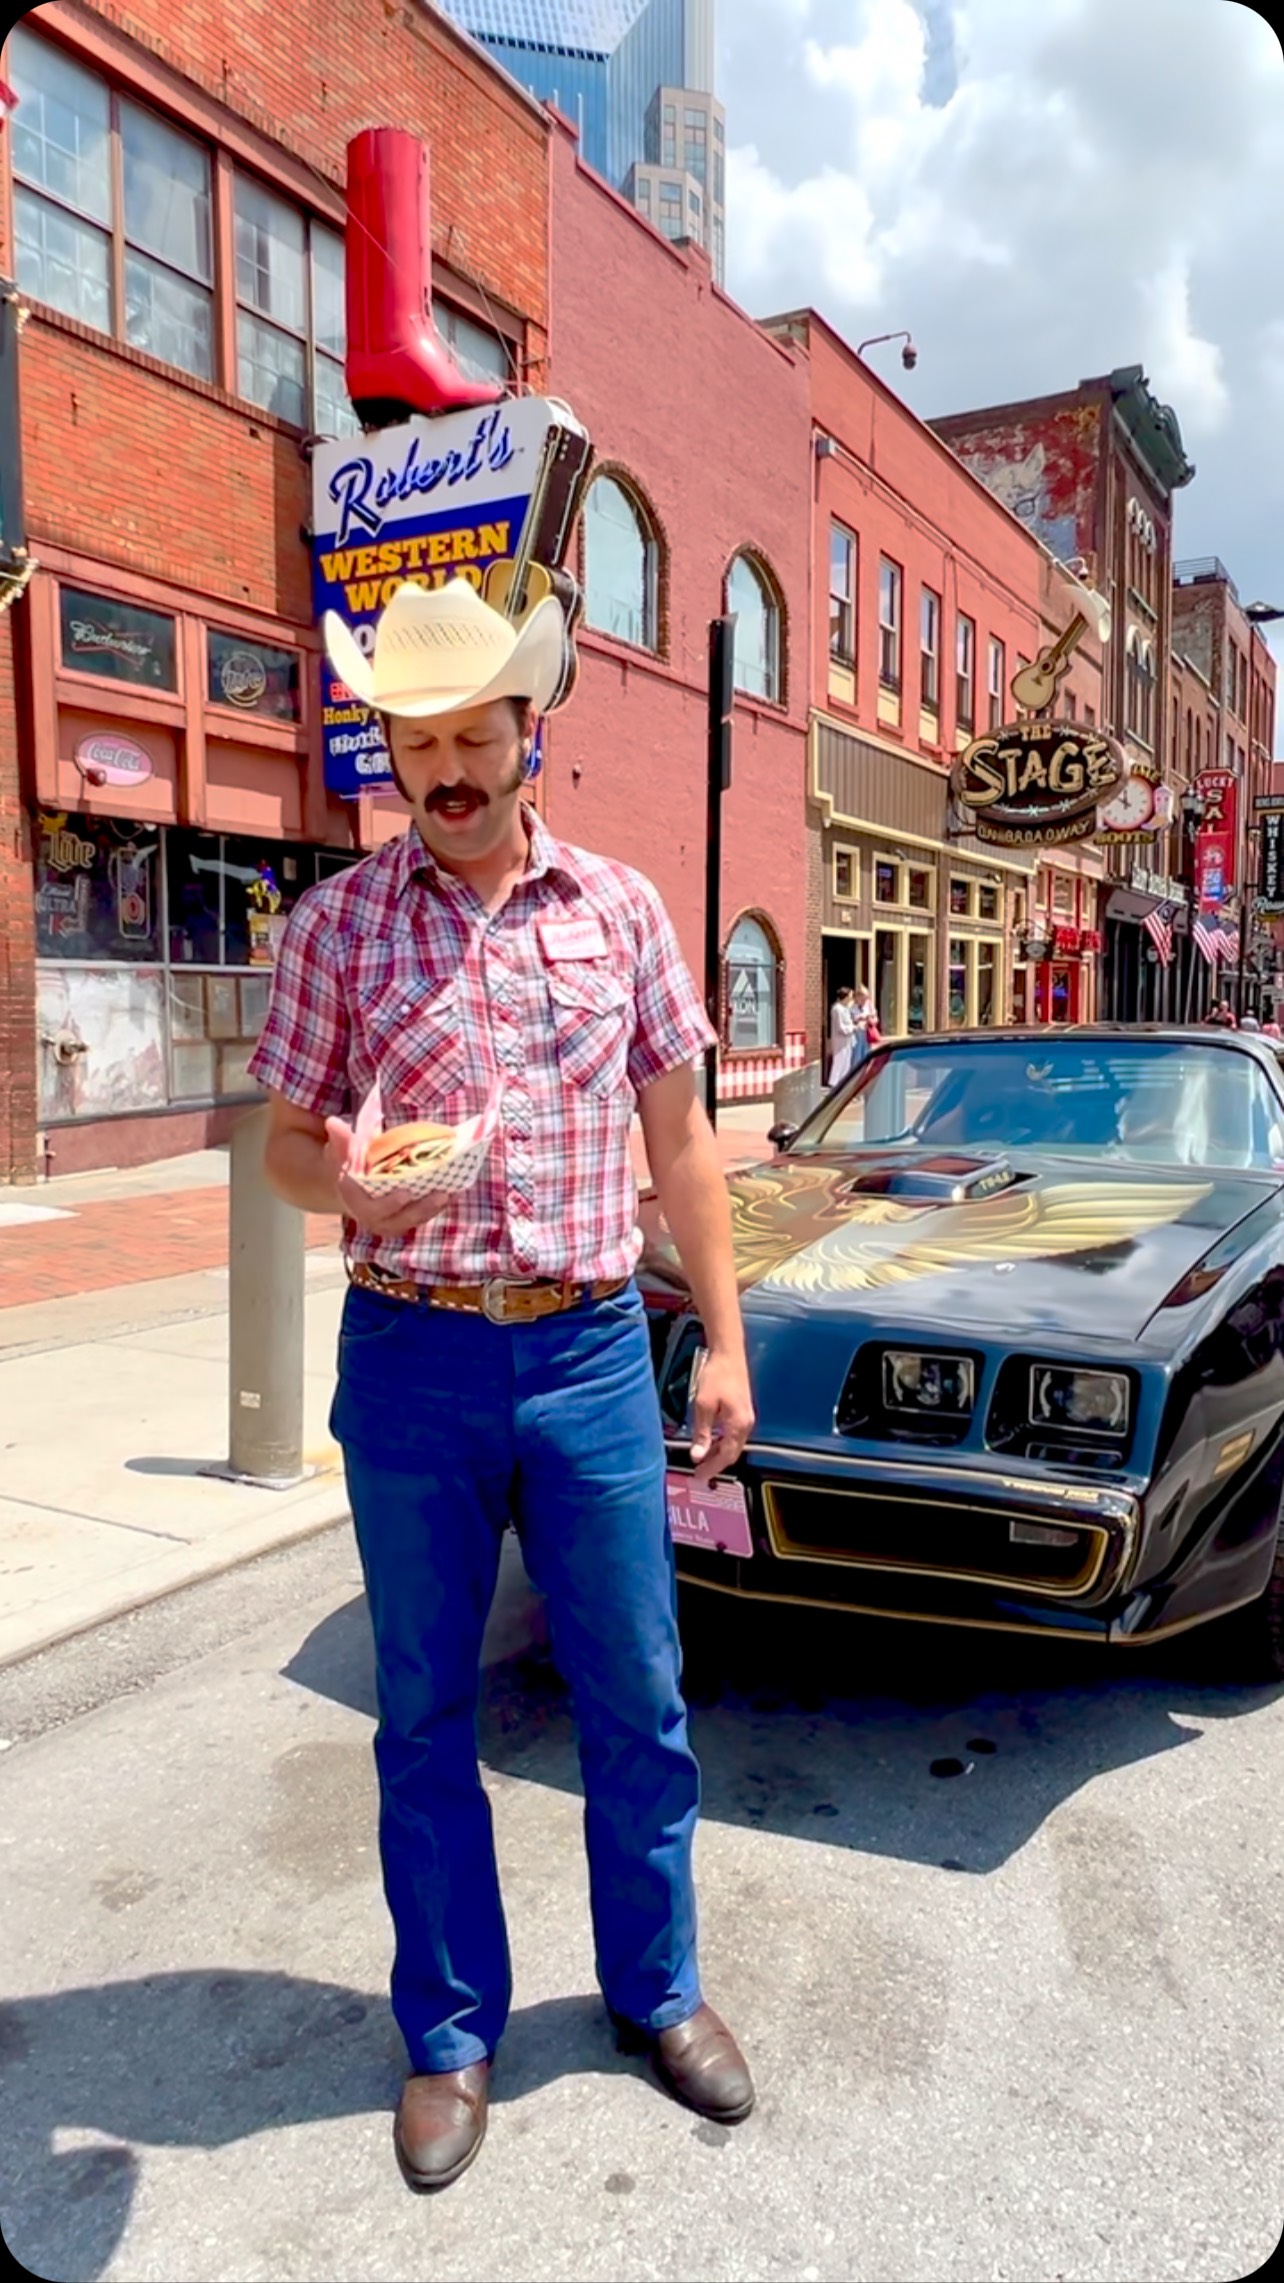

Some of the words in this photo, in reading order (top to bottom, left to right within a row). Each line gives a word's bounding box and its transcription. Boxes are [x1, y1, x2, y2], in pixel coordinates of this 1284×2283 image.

[328, 409, 515, 548] Robert's
[319, 521, 510, 583] WESTERN
[323, 703, 370, 727] Honky
[1021, 726, 1053, 741] THE
[959, 738, 1116, 806] STAGE
[1197, 777, 1235, 789] LUCKY
[1006, 818, 1092, 843] BROADWAY
[1265, 815, 1281, 898] WHISKEY
[667, 1505, 710, 1533] ILLA
